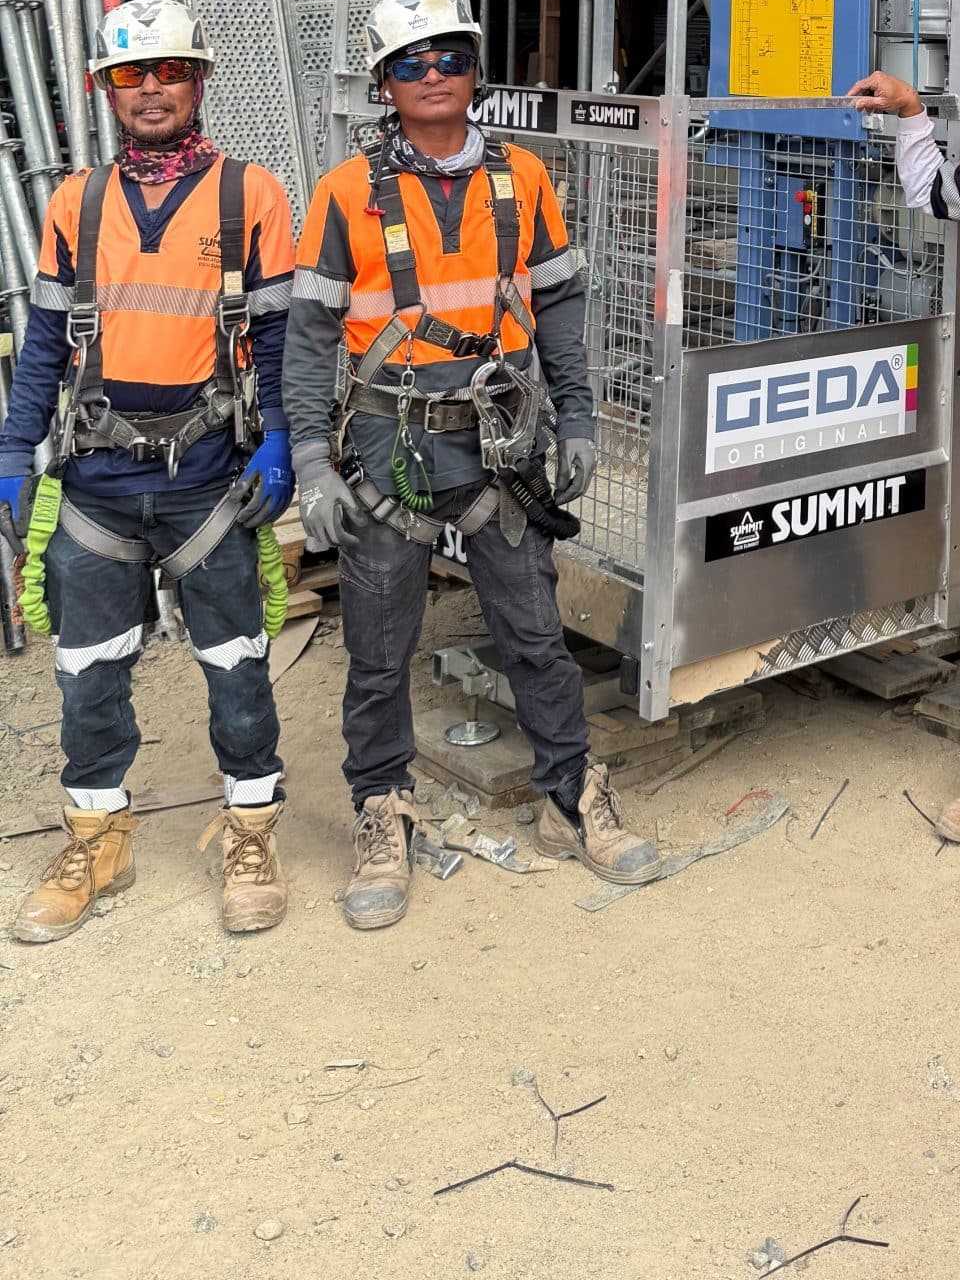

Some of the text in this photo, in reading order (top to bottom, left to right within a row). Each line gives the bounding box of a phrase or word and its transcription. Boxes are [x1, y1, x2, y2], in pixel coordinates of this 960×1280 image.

[589, 105, 636, 126] SUMMIT
[198, 237, 221, 248] SUM
[716, 359, 900, 433] GEDA
[728, 420, 888, 463] ORIGINAL
[771, 475, 906, 543] SUMMIT
[730, 520, 764, 537] SUMMIT
